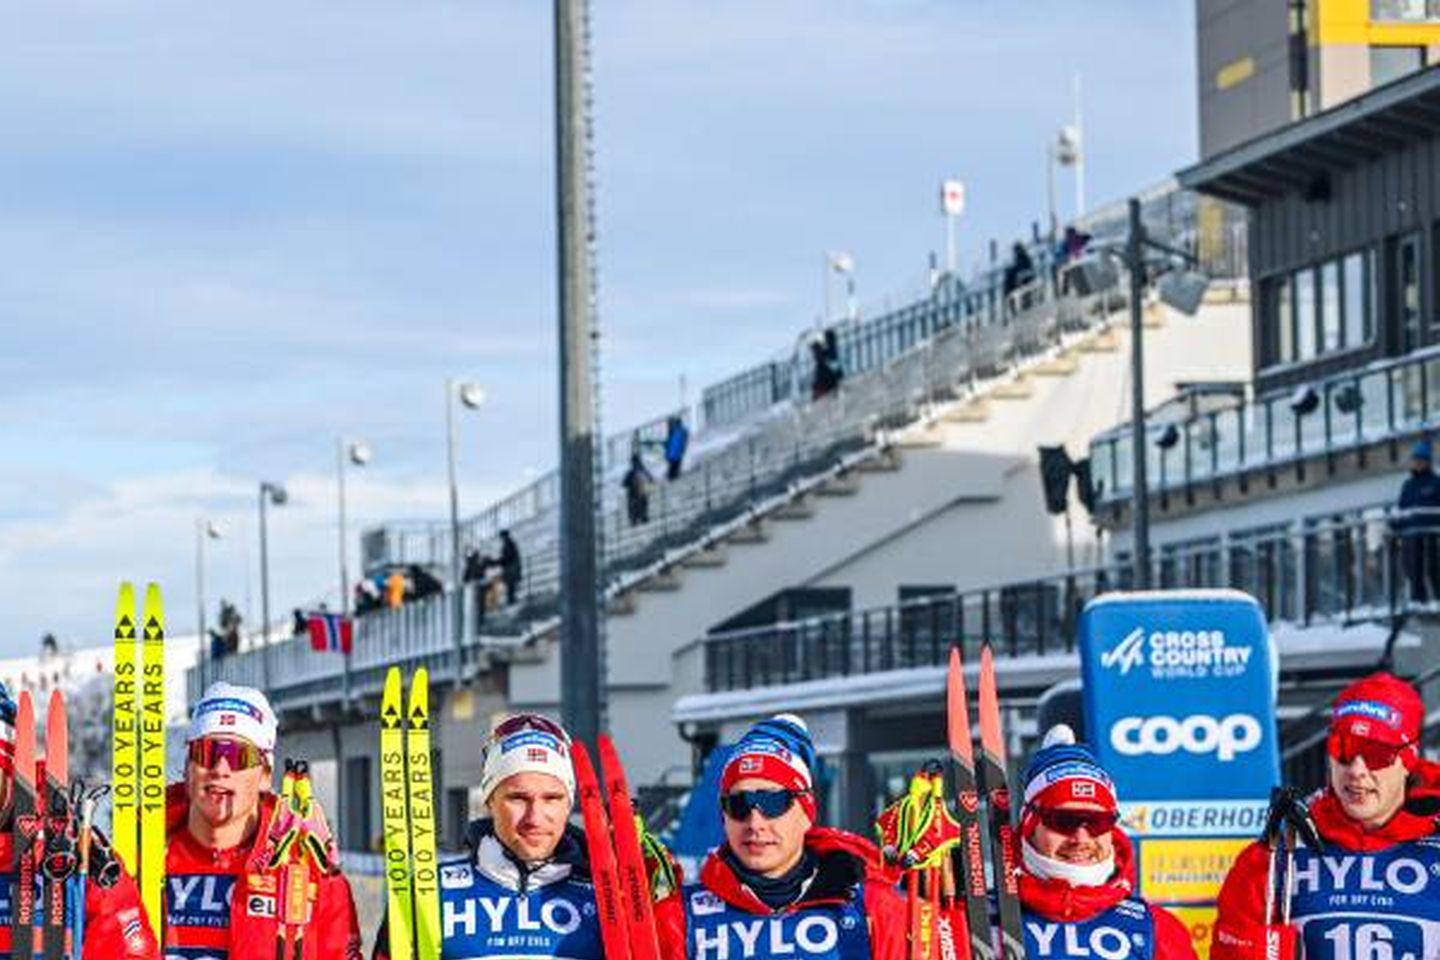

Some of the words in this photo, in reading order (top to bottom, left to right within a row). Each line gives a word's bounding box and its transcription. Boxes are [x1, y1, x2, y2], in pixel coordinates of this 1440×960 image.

[1150, 631, 1225, 648] CROSS
[1150, 647, 1252, 665] COUNTRY
[1152, 666, 1210, 678] WORLD
[1214, 665, 1247, 678] CUP
[115, 661, 136, 751] YEARS
[144, 663, 163, 751] YEARS
[1111, 713, 1262, 762] coop
[115, 763, 136, 812] 100
[144, 765, 163, 813] 100
[383, 751, 406, 842] YEARS
[410, 751, 432, 840] YEARS
[170, 875, 234, 911] YL
[388, 849, 408, 896] 100
[416, 849, 436, 896] 100
[1292, 855, 1429, 895] HYLO
[441, 896, 582, 939] HYLO
[1026, 923, 1131, 960] YLO
